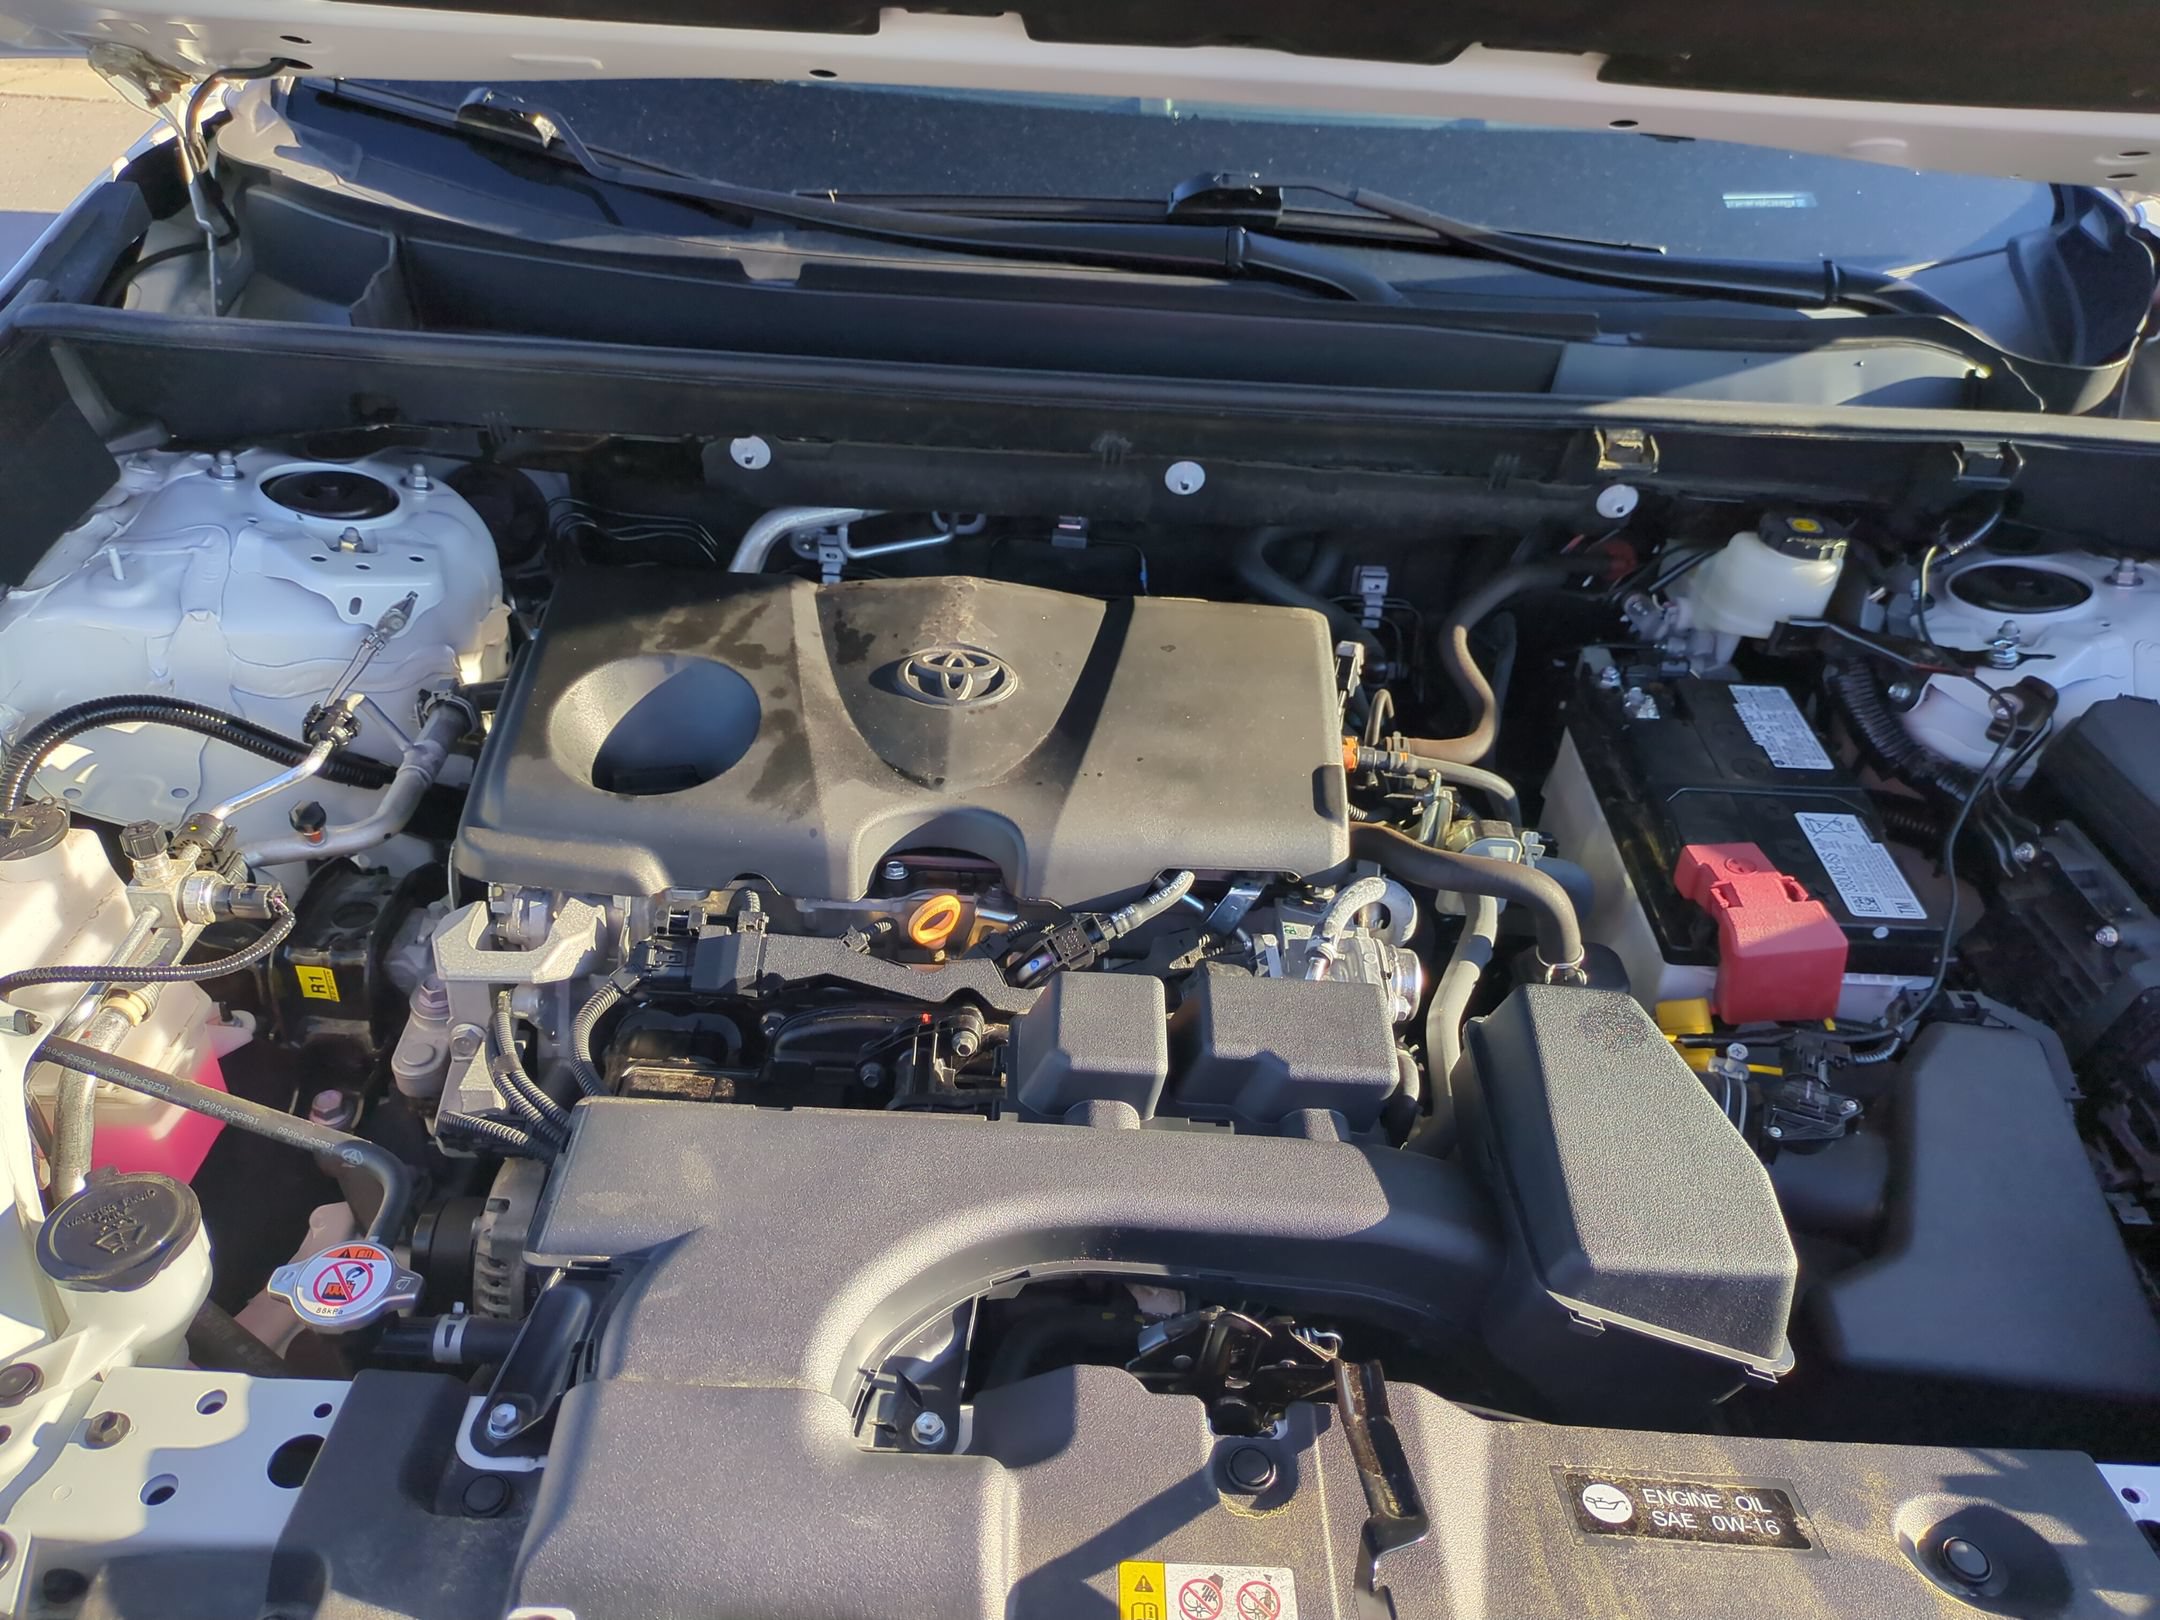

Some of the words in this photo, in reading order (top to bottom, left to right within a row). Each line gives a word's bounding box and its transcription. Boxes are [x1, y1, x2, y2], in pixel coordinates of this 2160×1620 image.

[308, 976, 327, 994] R1
[1642, 1488, 1723, 1509] ENGINE
[1735, 1495, 1773, 1513] OIL
[1651, 1510, 1698, 1529] SAE
[1711, 1515, 1781, 1536] 0W-16
